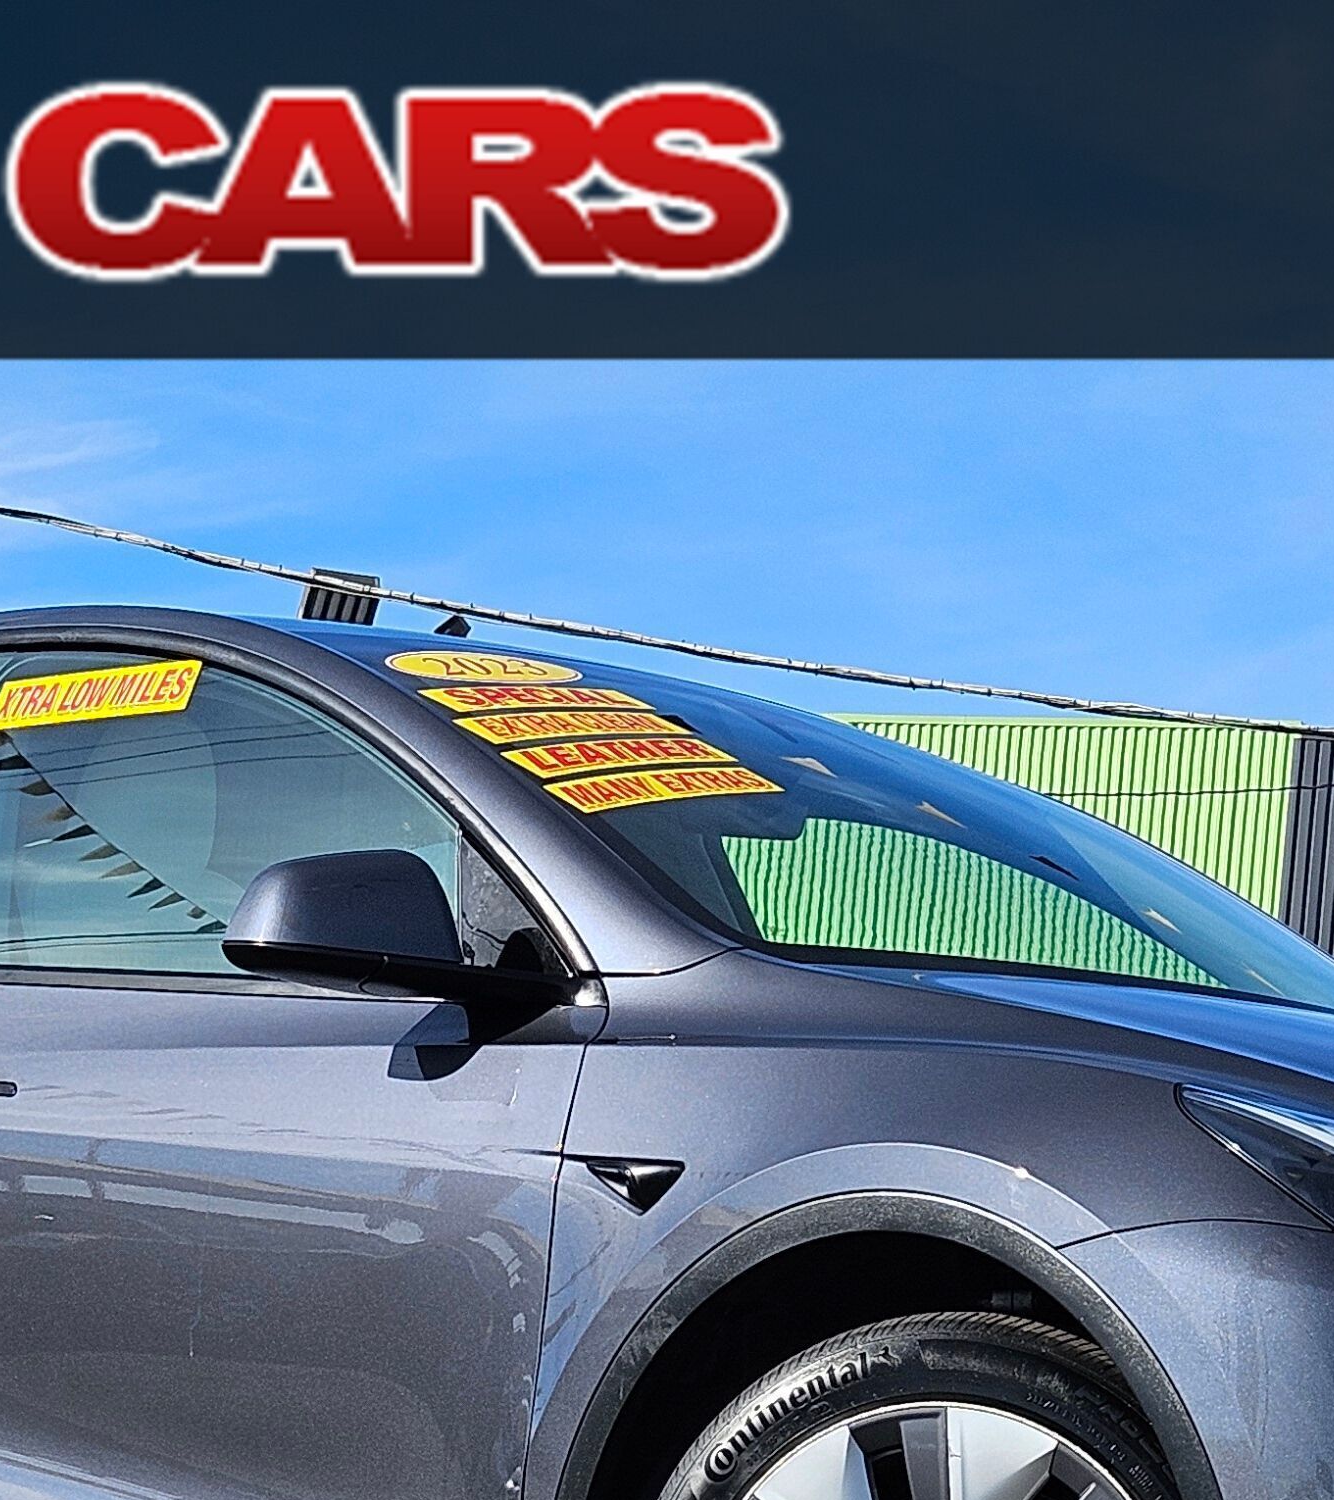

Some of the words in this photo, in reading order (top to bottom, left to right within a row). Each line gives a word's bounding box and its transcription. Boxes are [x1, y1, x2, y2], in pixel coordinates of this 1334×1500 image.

[422, 657, 548, 676] 2023
[57, 675, 115, 714] LOW
[109, 666, 195, 709] MILES
[442, 687, 632, 708] SPECIAL
[473, 713, 572, 740] EXTRA
[577, 713, 668, 735] CLEAN
[520, 738, 719, 773] LEATHER
[560, 773, 654, 810] MANY
[651, 769, 771, 795] EXTRAS
[704, 1351, 872, 1483] Continental
